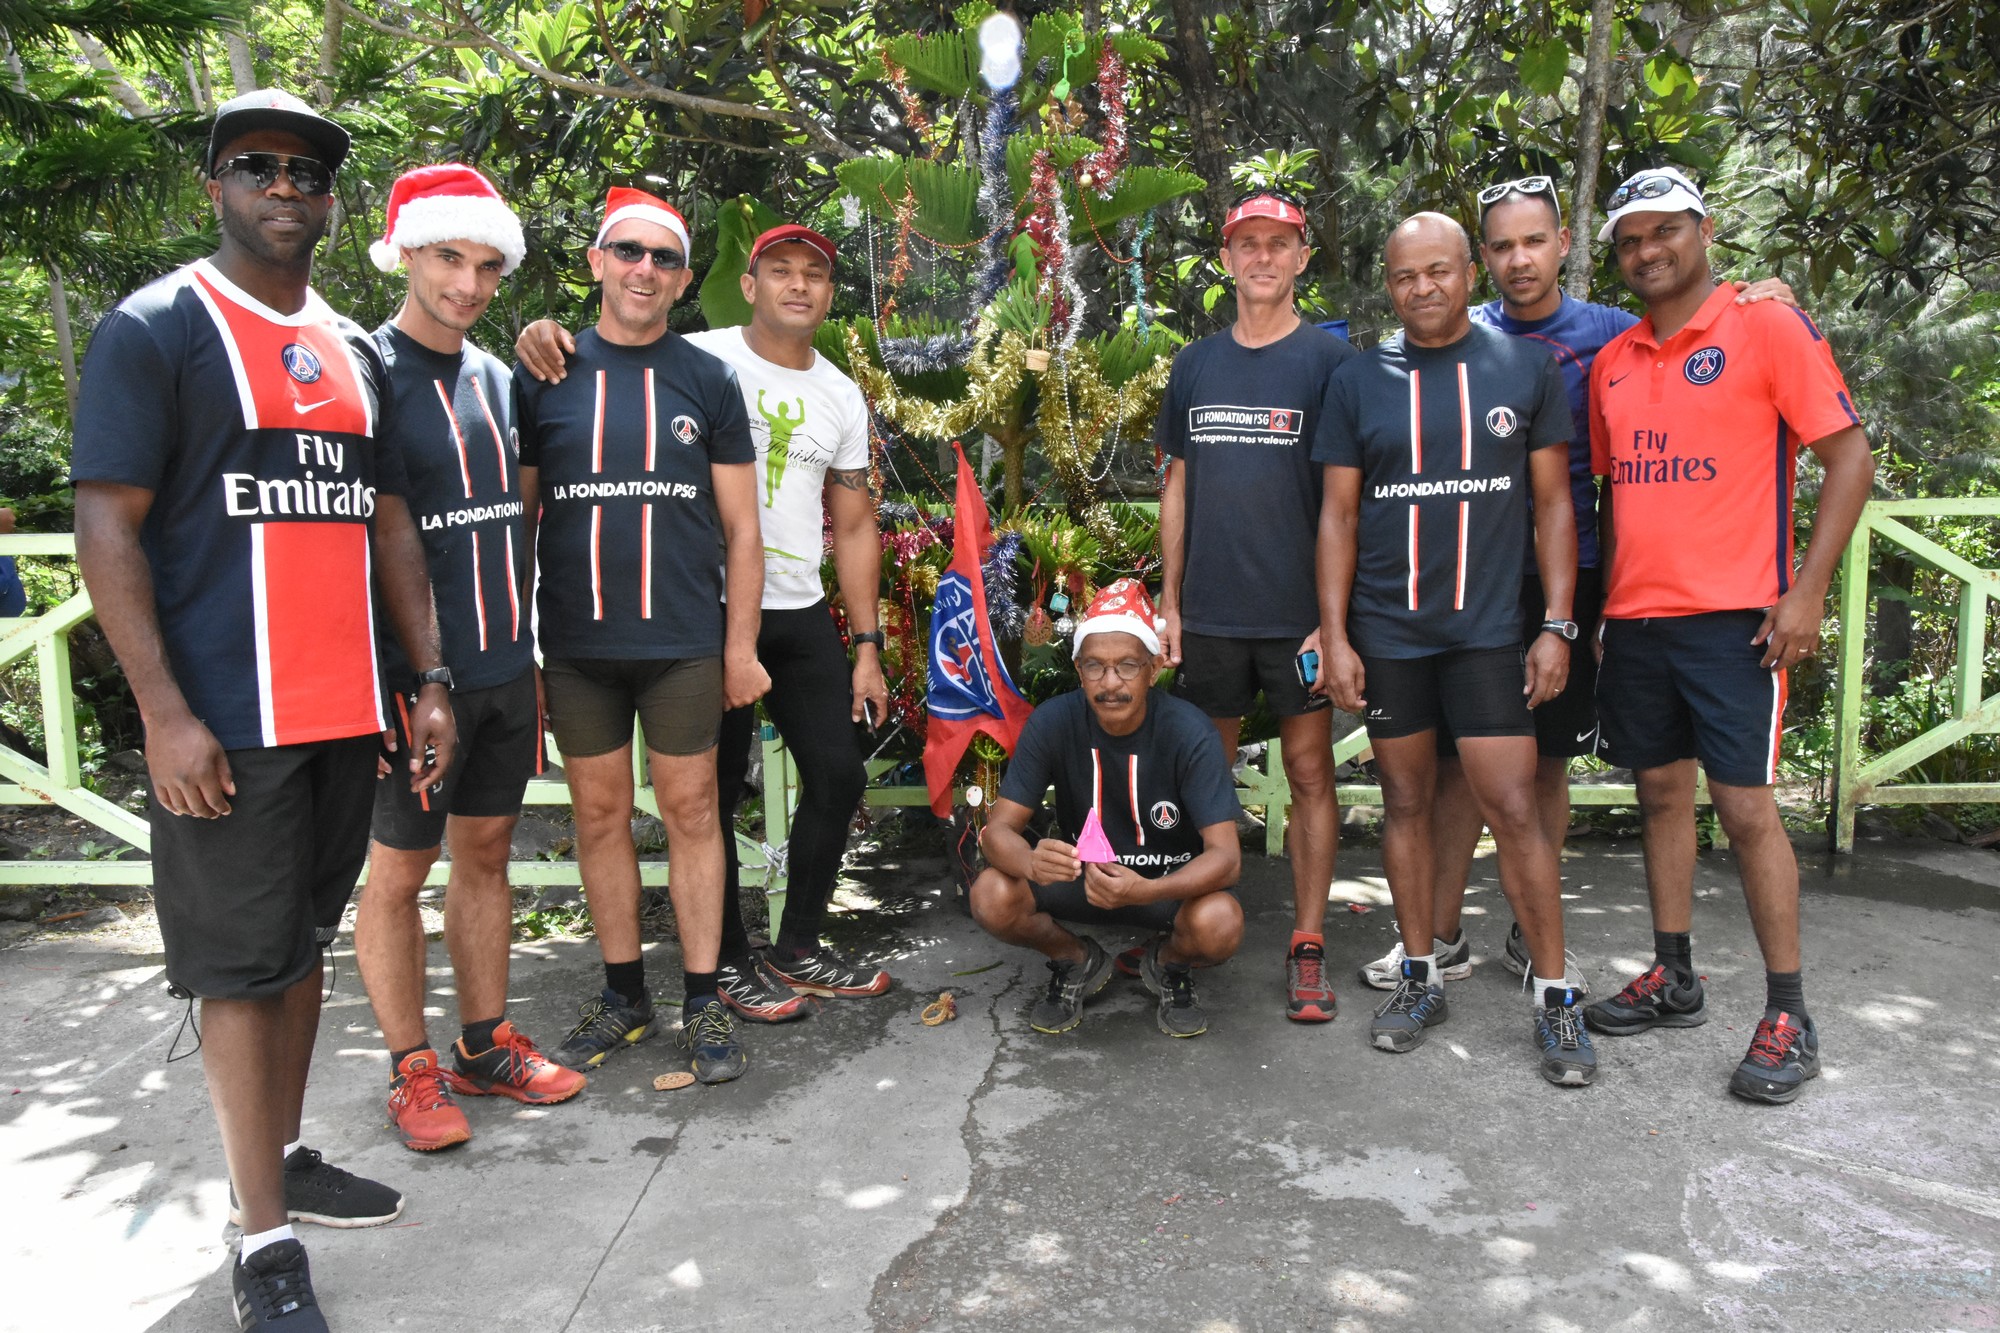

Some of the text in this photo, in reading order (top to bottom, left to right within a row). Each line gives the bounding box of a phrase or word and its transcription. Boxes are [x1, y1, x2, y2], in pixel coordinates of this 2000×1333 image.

[1694, 350, 1719, 361] PARIS
[1204, 411, 1253, 425] FONDATION
[1238, 435, 1257, 443] nos
[1633, 429, 1668, 454] Fly
[295, 433, 344, 473] Fly
[760, 436, 829, 467] Finisher
[553, 481, 697, 500] LA FONDATION PSG
[1374, 476, 1512, 499] LA FONDATION PSG
[421, 502, 519, 531] LA FONDATION
[1163, 852, 1192, 866] PSG
